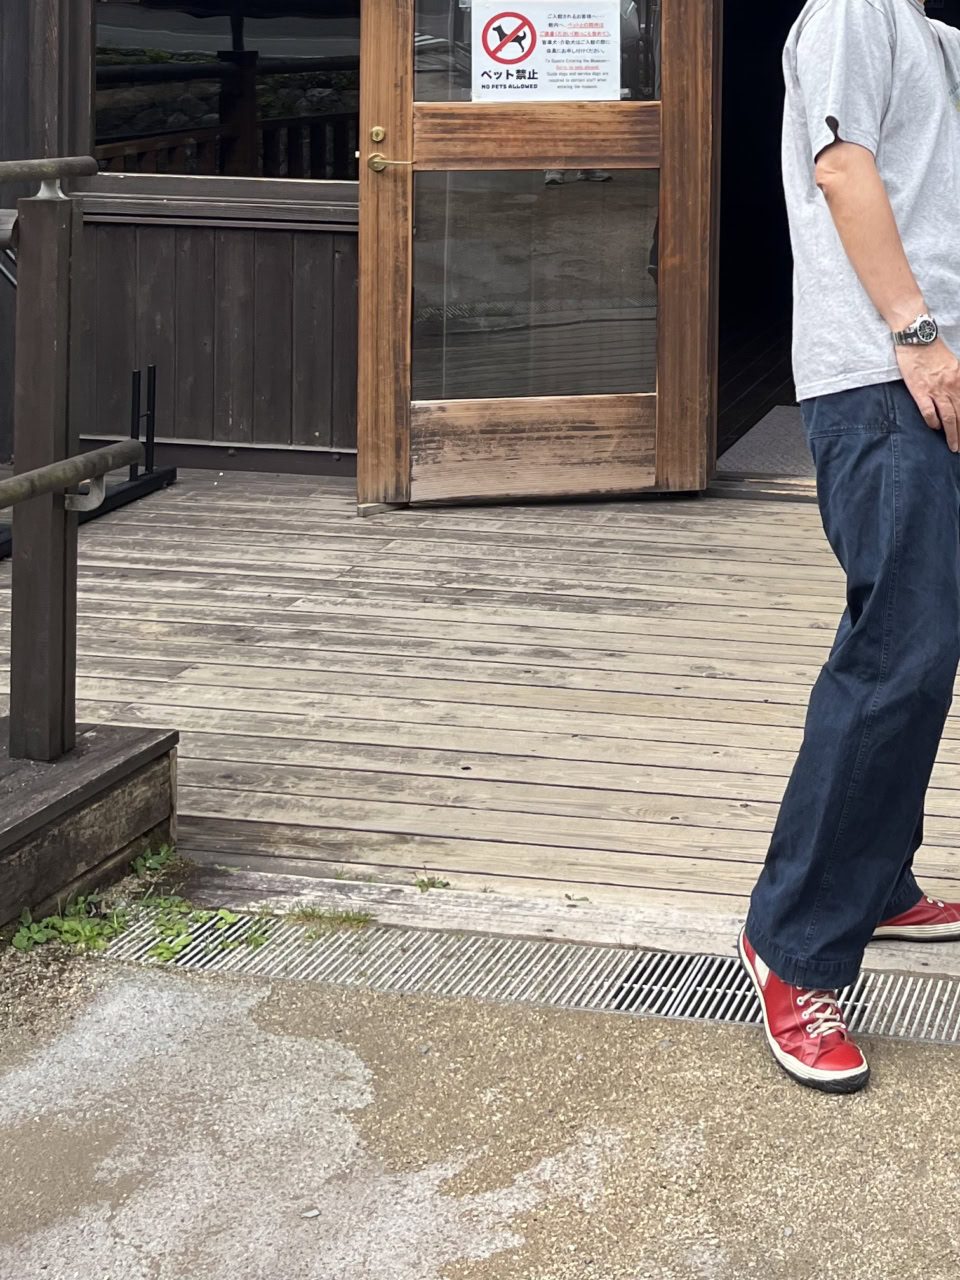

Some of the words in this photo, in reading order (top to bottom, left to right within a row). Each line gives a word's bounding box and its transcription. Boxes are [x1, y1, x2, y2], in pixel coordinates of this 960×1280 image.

[481, 69, 538, 80] ペット禁止
